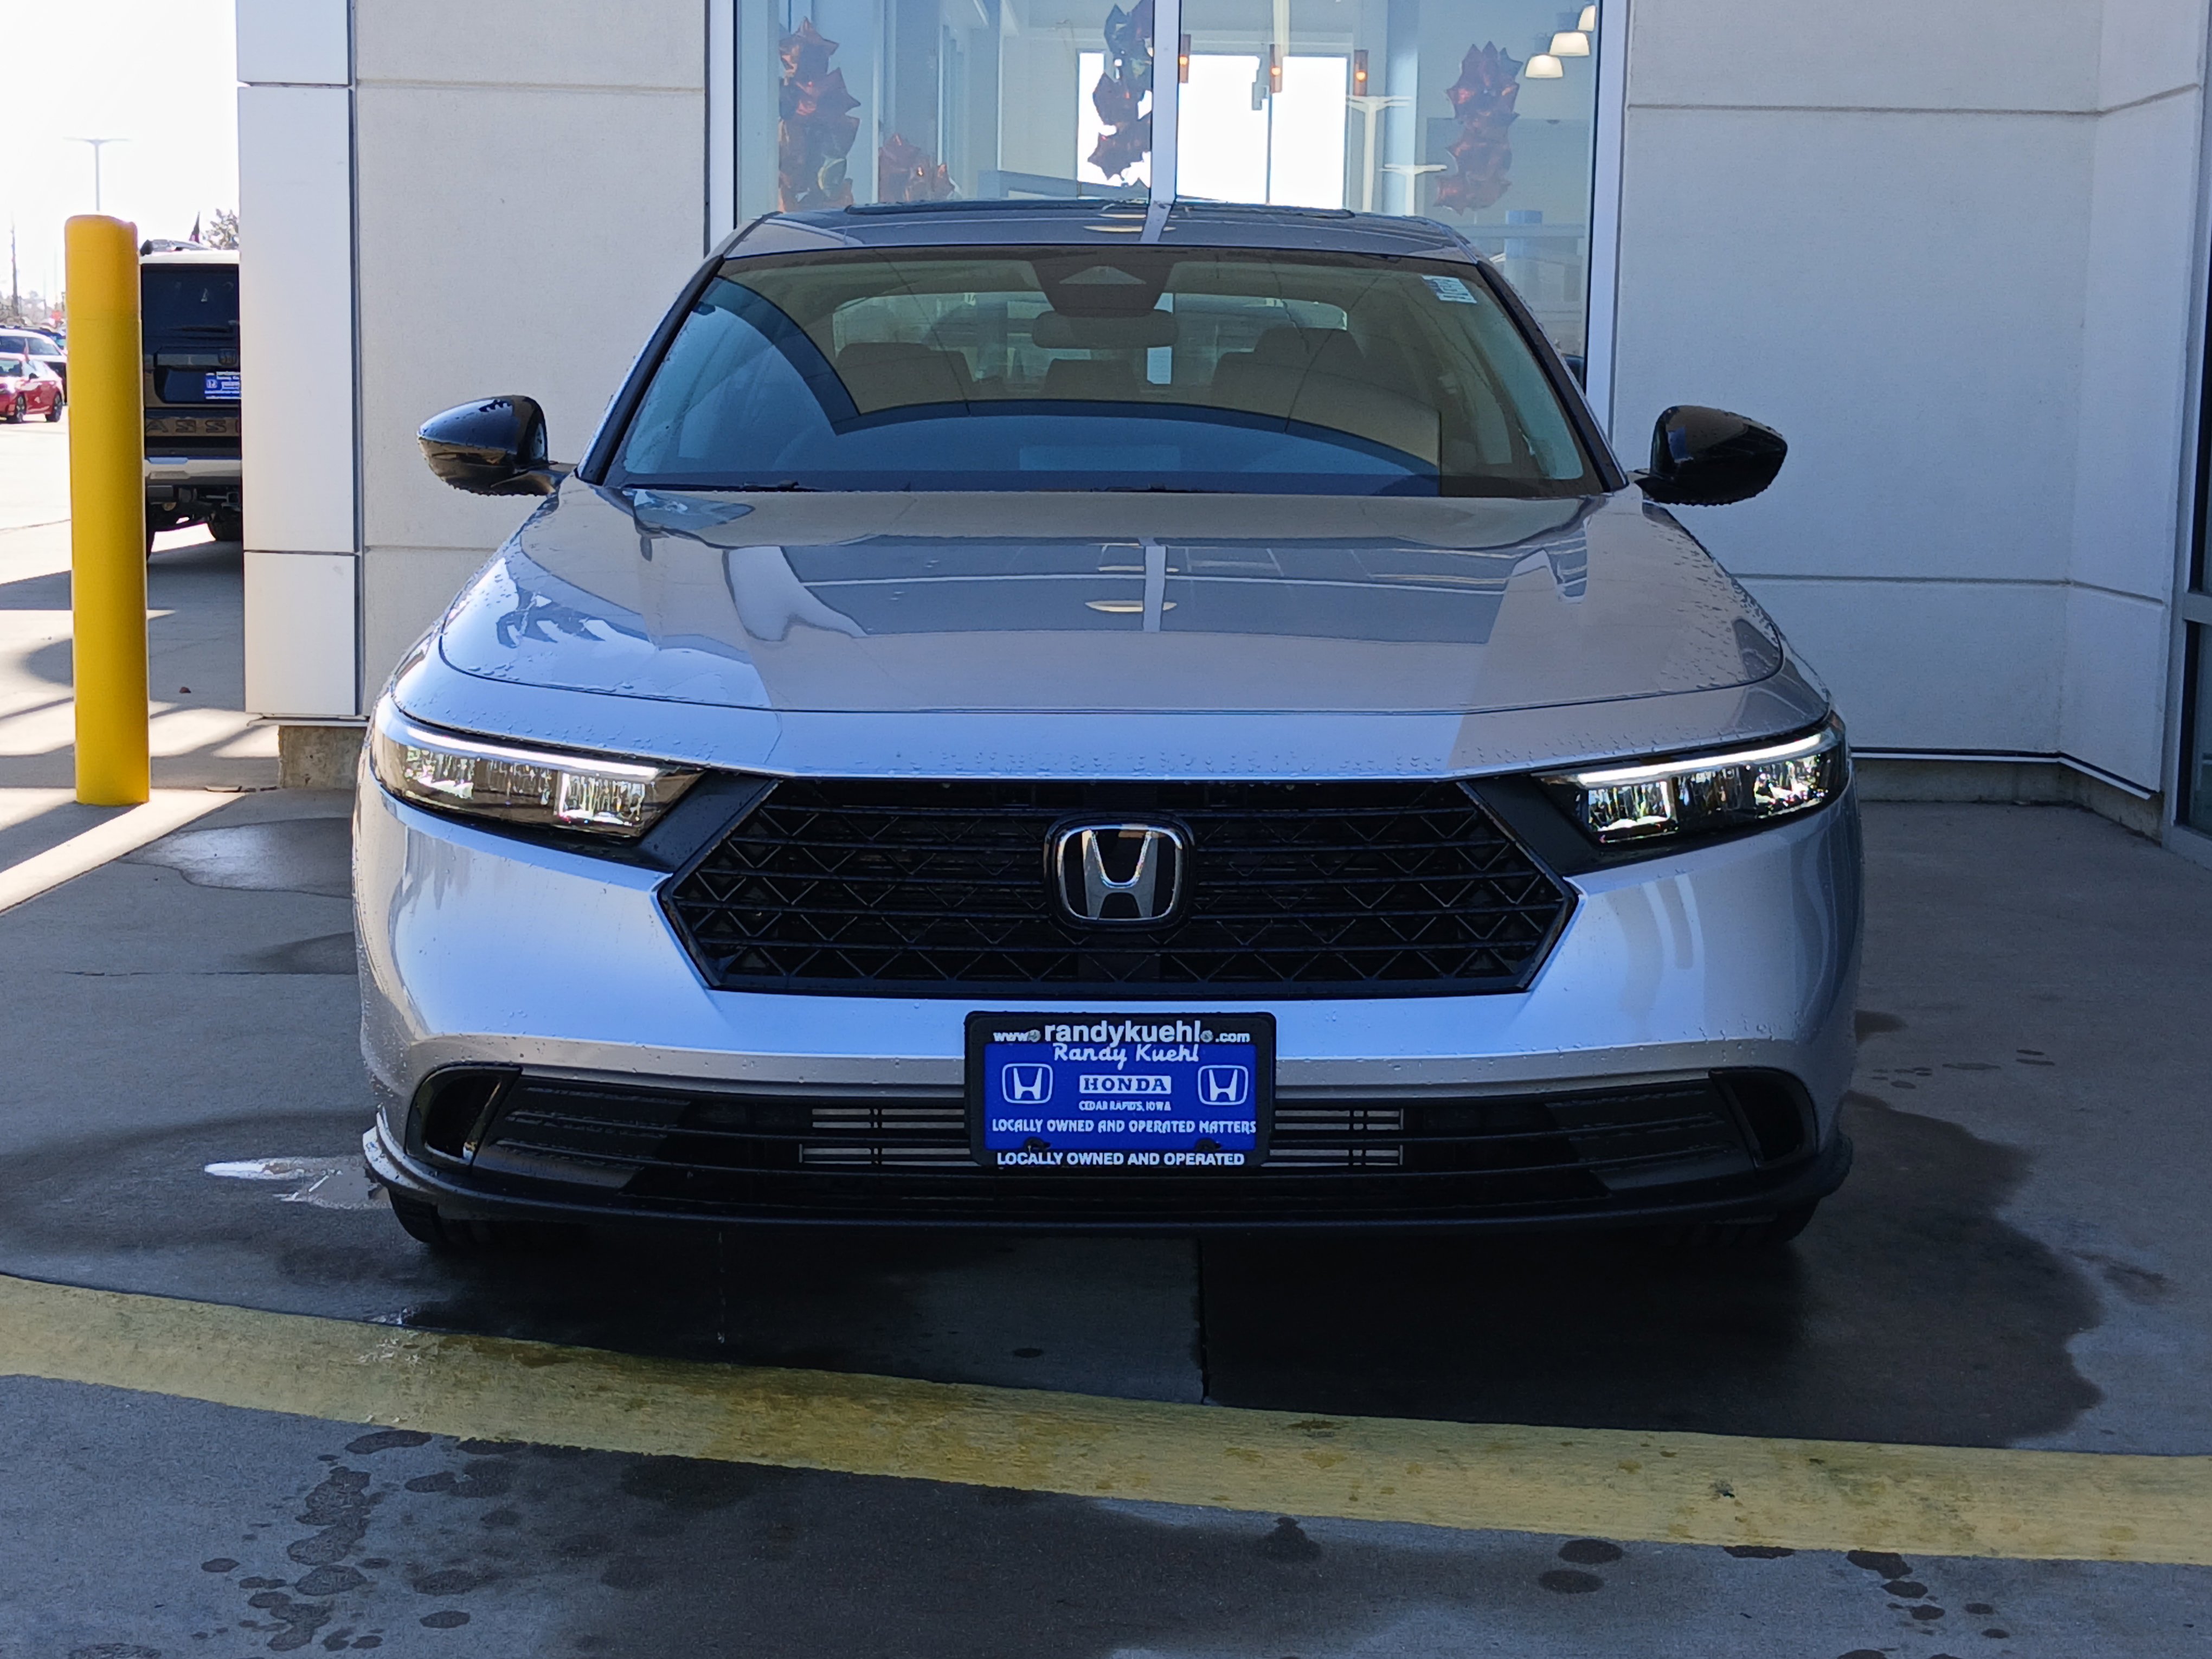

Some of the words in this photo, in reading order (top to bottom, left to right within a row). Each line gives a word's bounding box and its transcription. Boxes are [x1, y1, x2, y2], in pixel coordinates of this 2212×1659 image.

[1044, 1020, 1201, 1047] randykuehl
[1215, 1032, 1250, 1043] .com
[1052, 1043, 1127, 1071] Randy
[1135, 1044, 1199, 1062] Kuehl
[1083, 1077, 1167, 1092] HONDA
[1146, 1101, 1172, 1111] IOWA
[992, 1118, 1043, 1133] LOCALLY
[1046, 1119, 1095, 1133] OWNED
[1097, 1120, 1126, 1134] AND
[1128, 1120, 1196, 1134] OPERATED
[1199, 1120, 1257, 1135] MATTERS
[996, 1152, 1063, 1166] LOCALLY
[1066, 1152, 1124, 1166] OWNED
[1127, 1153, 1160, 1166] AND
[1163, 1153, 1245, 1166] OPERATED
